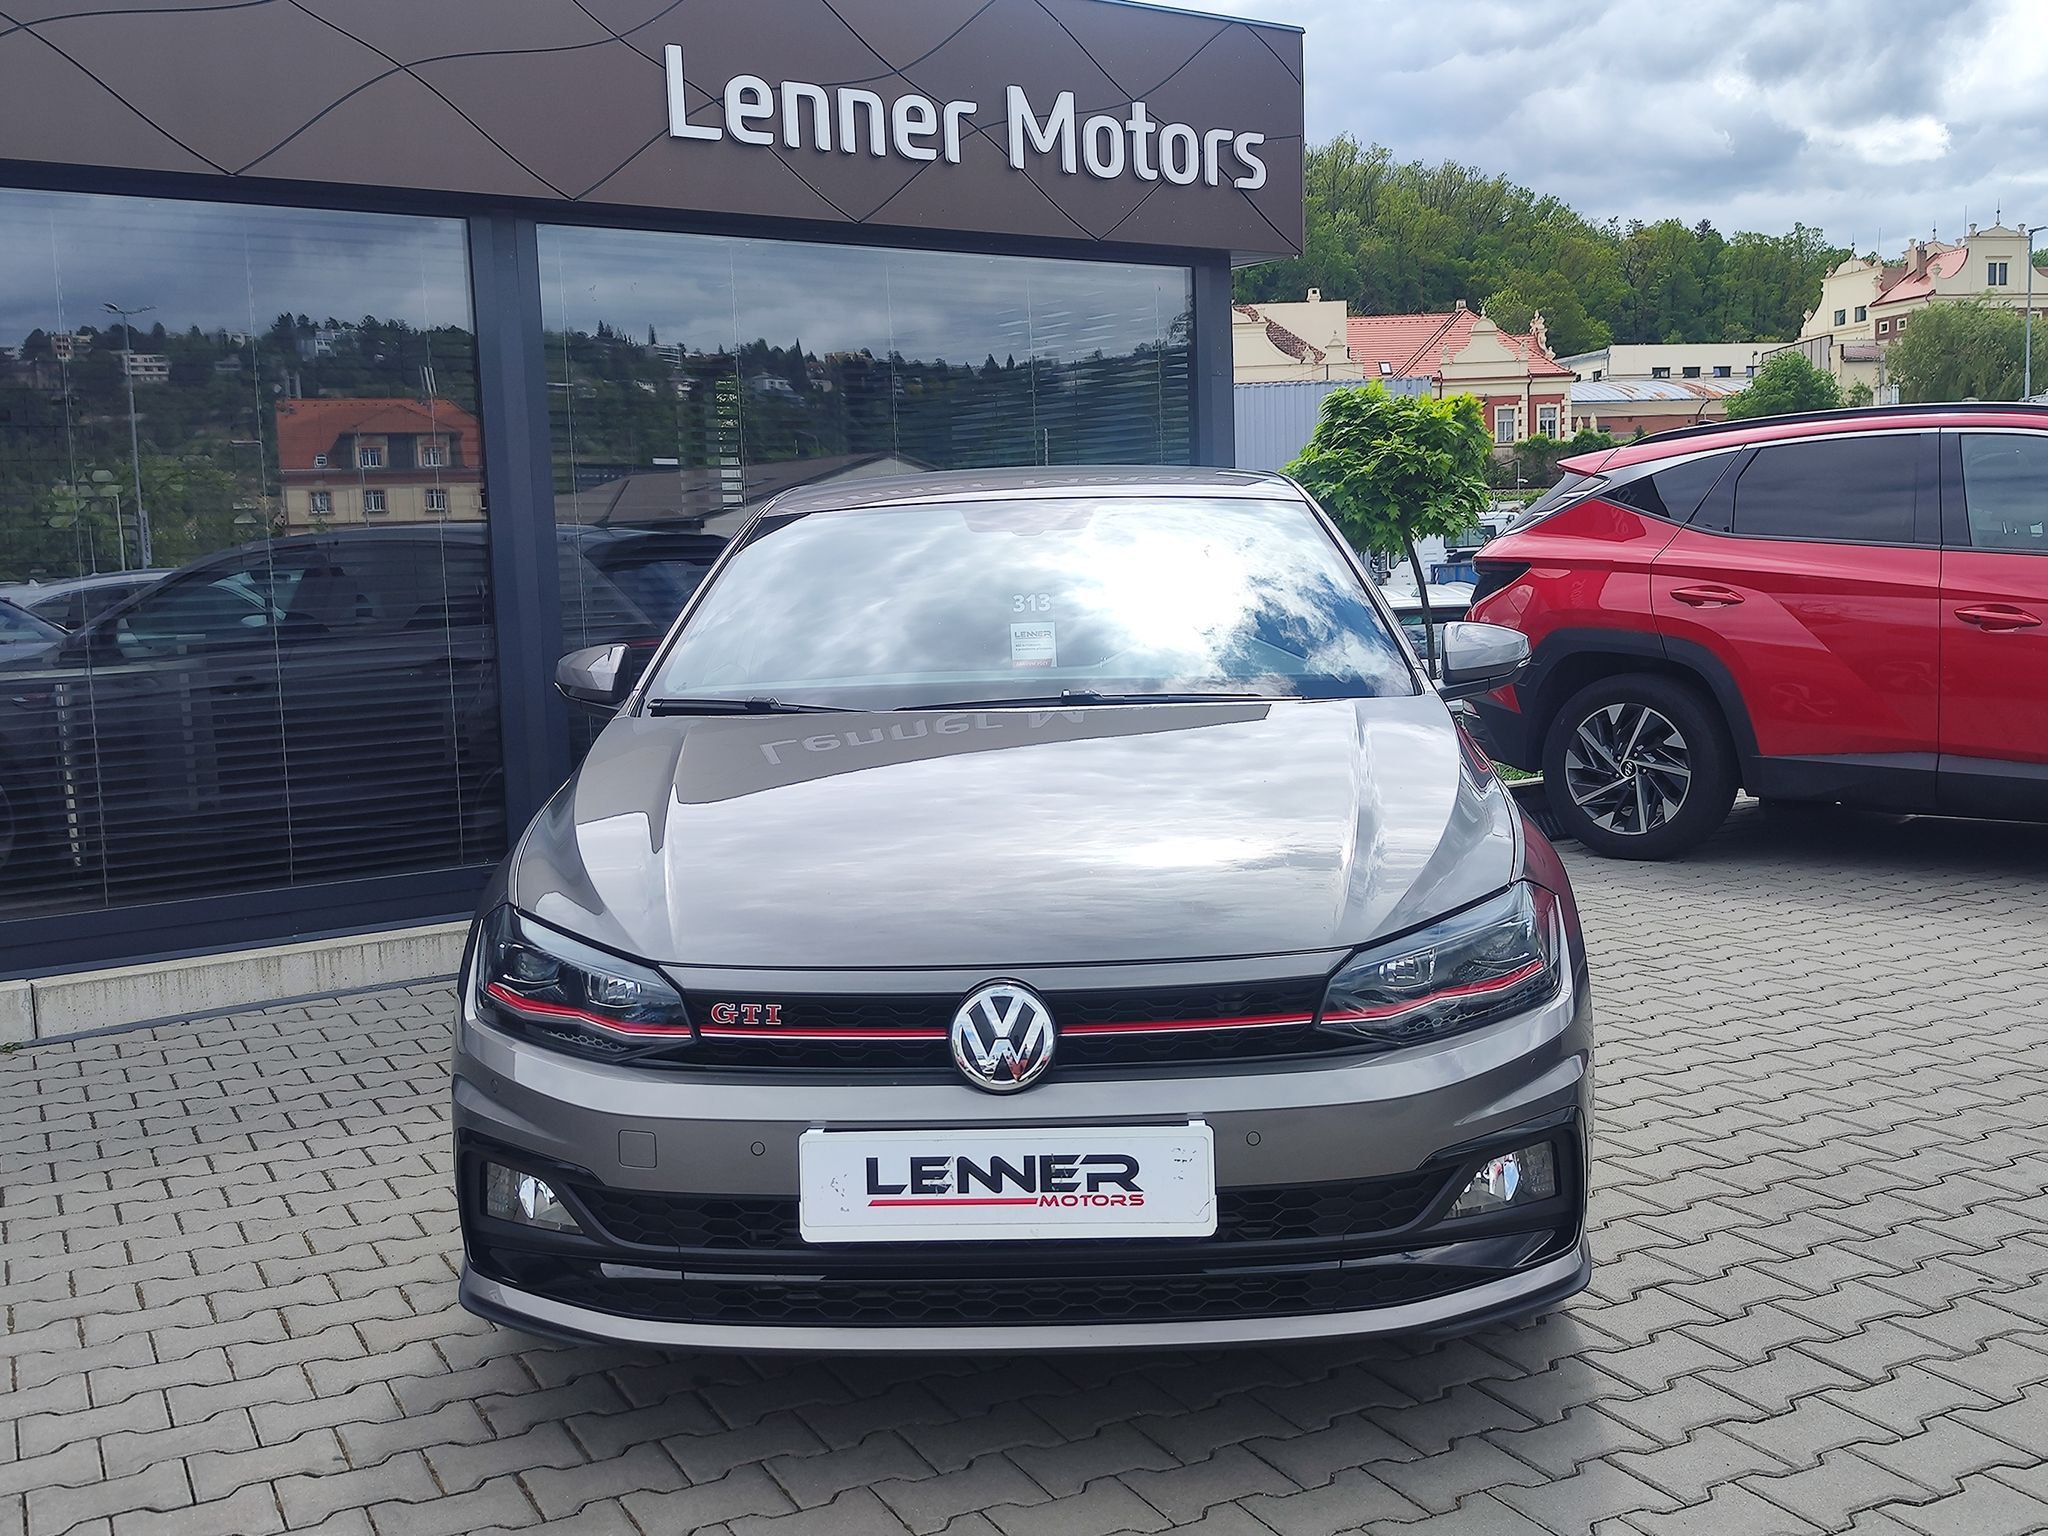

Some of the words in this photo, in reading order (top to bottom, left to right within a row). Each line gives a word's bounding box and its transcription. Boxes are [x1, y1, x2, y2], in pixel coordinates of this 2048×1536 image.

[664, 43, 978, 164] Lenner
[1006, 84, 1268, 190] Motors
[1012, 593, 1051, 613] 313
[710, 1002, 782, 1025] GTI
[866, 1154, 1144, 1195] LENNER
[1039, 1194, 1145, 1207] MOTORS
